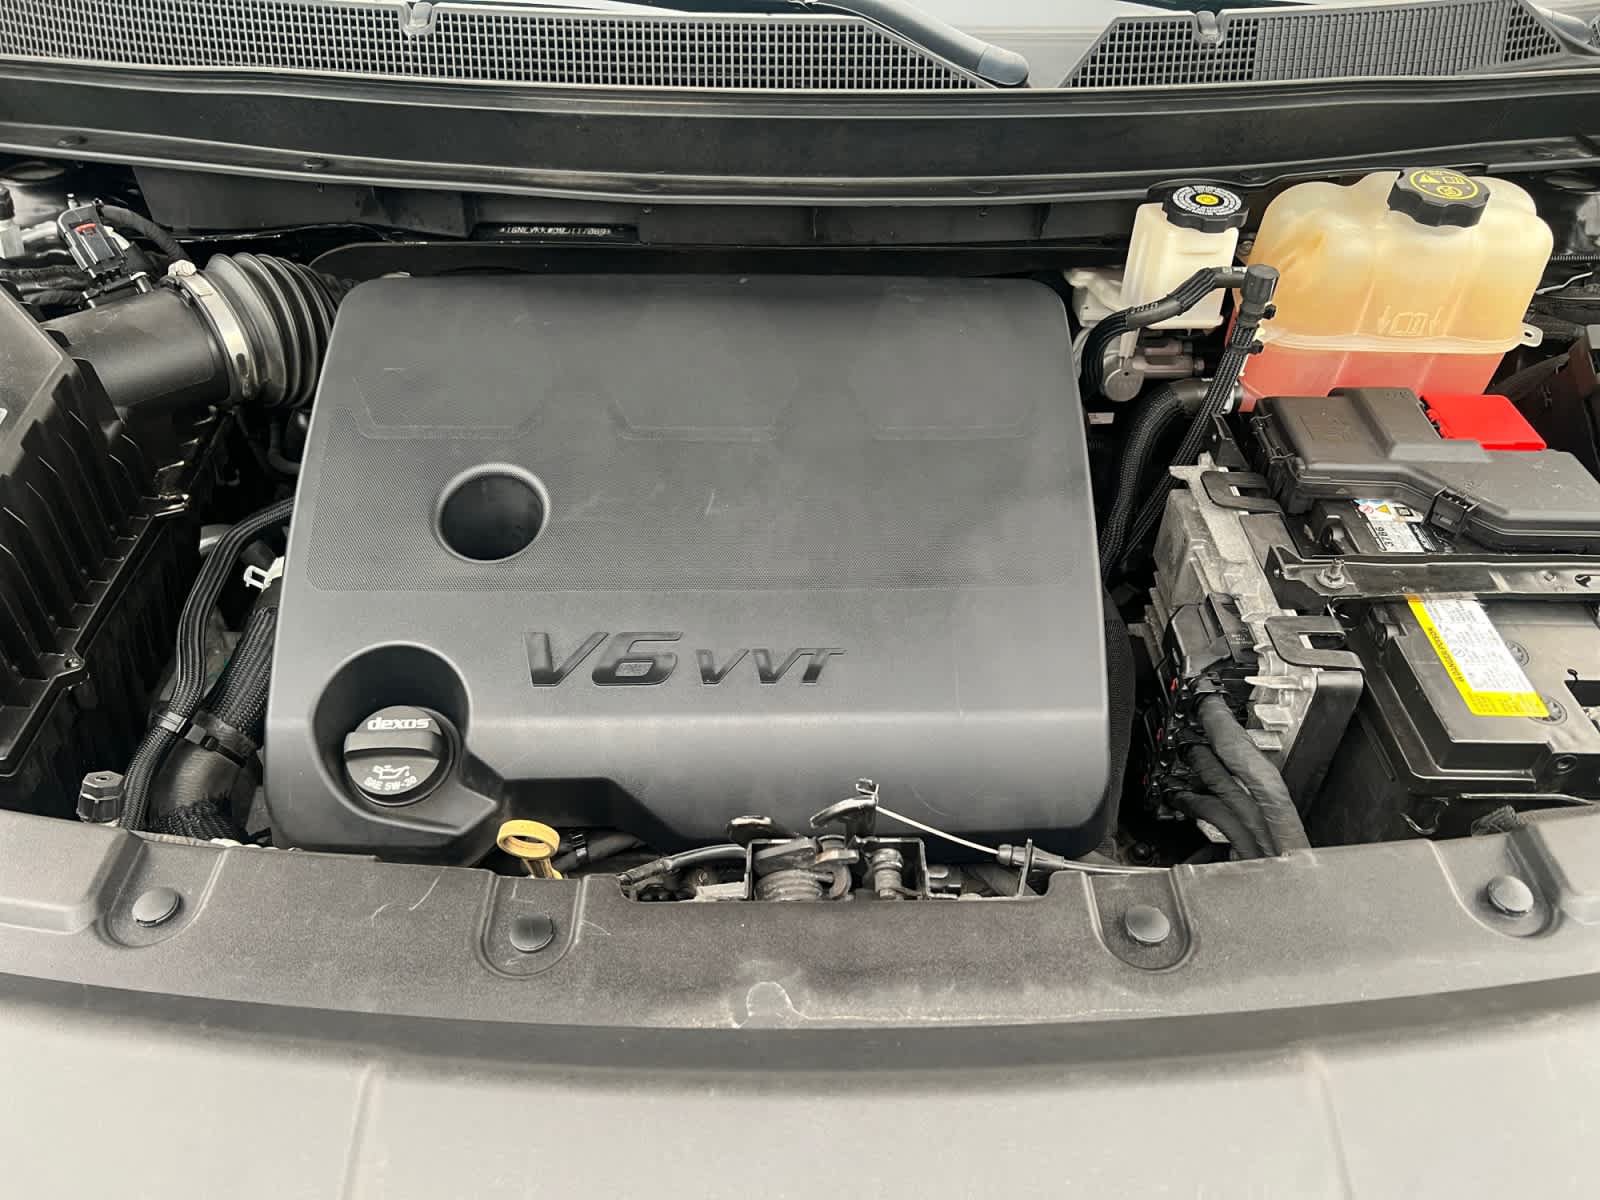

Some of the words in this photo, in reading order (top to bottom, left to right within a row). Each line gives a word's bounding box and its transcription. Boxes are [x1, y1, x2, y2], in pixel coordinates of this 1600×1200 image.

[523, 631, 684, 688] V6
[696, 647, 848, 686] VVT
[367, 716, 432, 731] dexos
